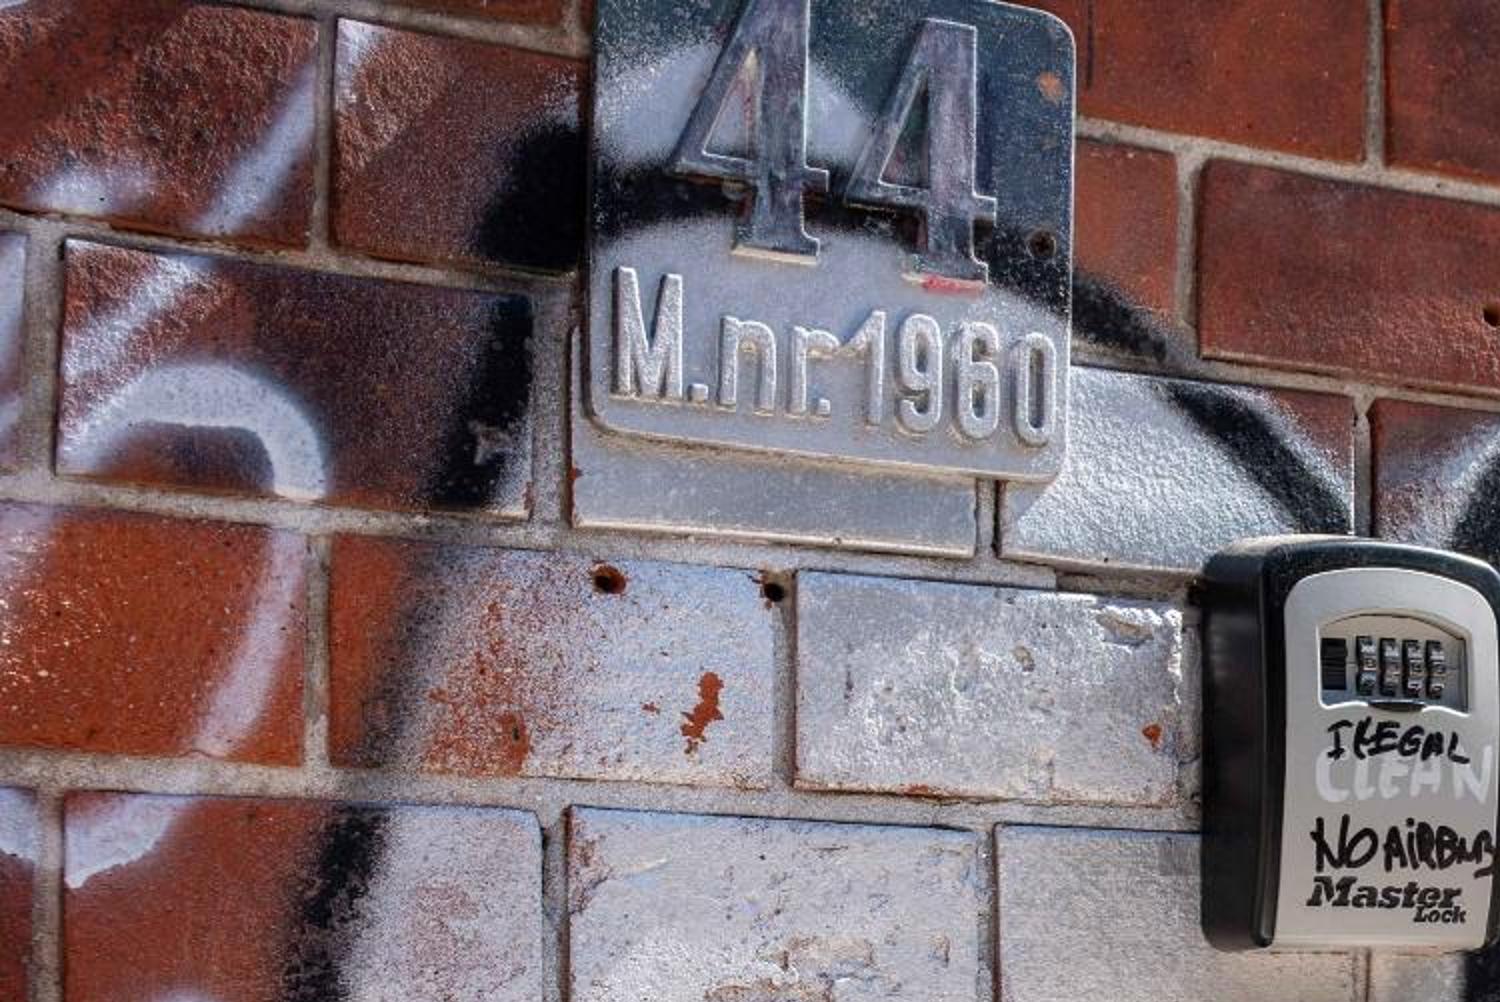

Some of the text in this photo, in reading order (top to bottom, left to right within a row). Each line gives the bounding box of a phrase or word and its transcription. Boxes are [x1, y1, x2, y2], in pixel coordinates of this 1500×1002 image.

[671, 0, 997, 294] 44
[1315, 745, 1493, 803] CLEAN
[1310, 814, 1379, 873] NO
[1306, 876, 1463, 909] Master
[1414, 905, 1466, 923] Lock
